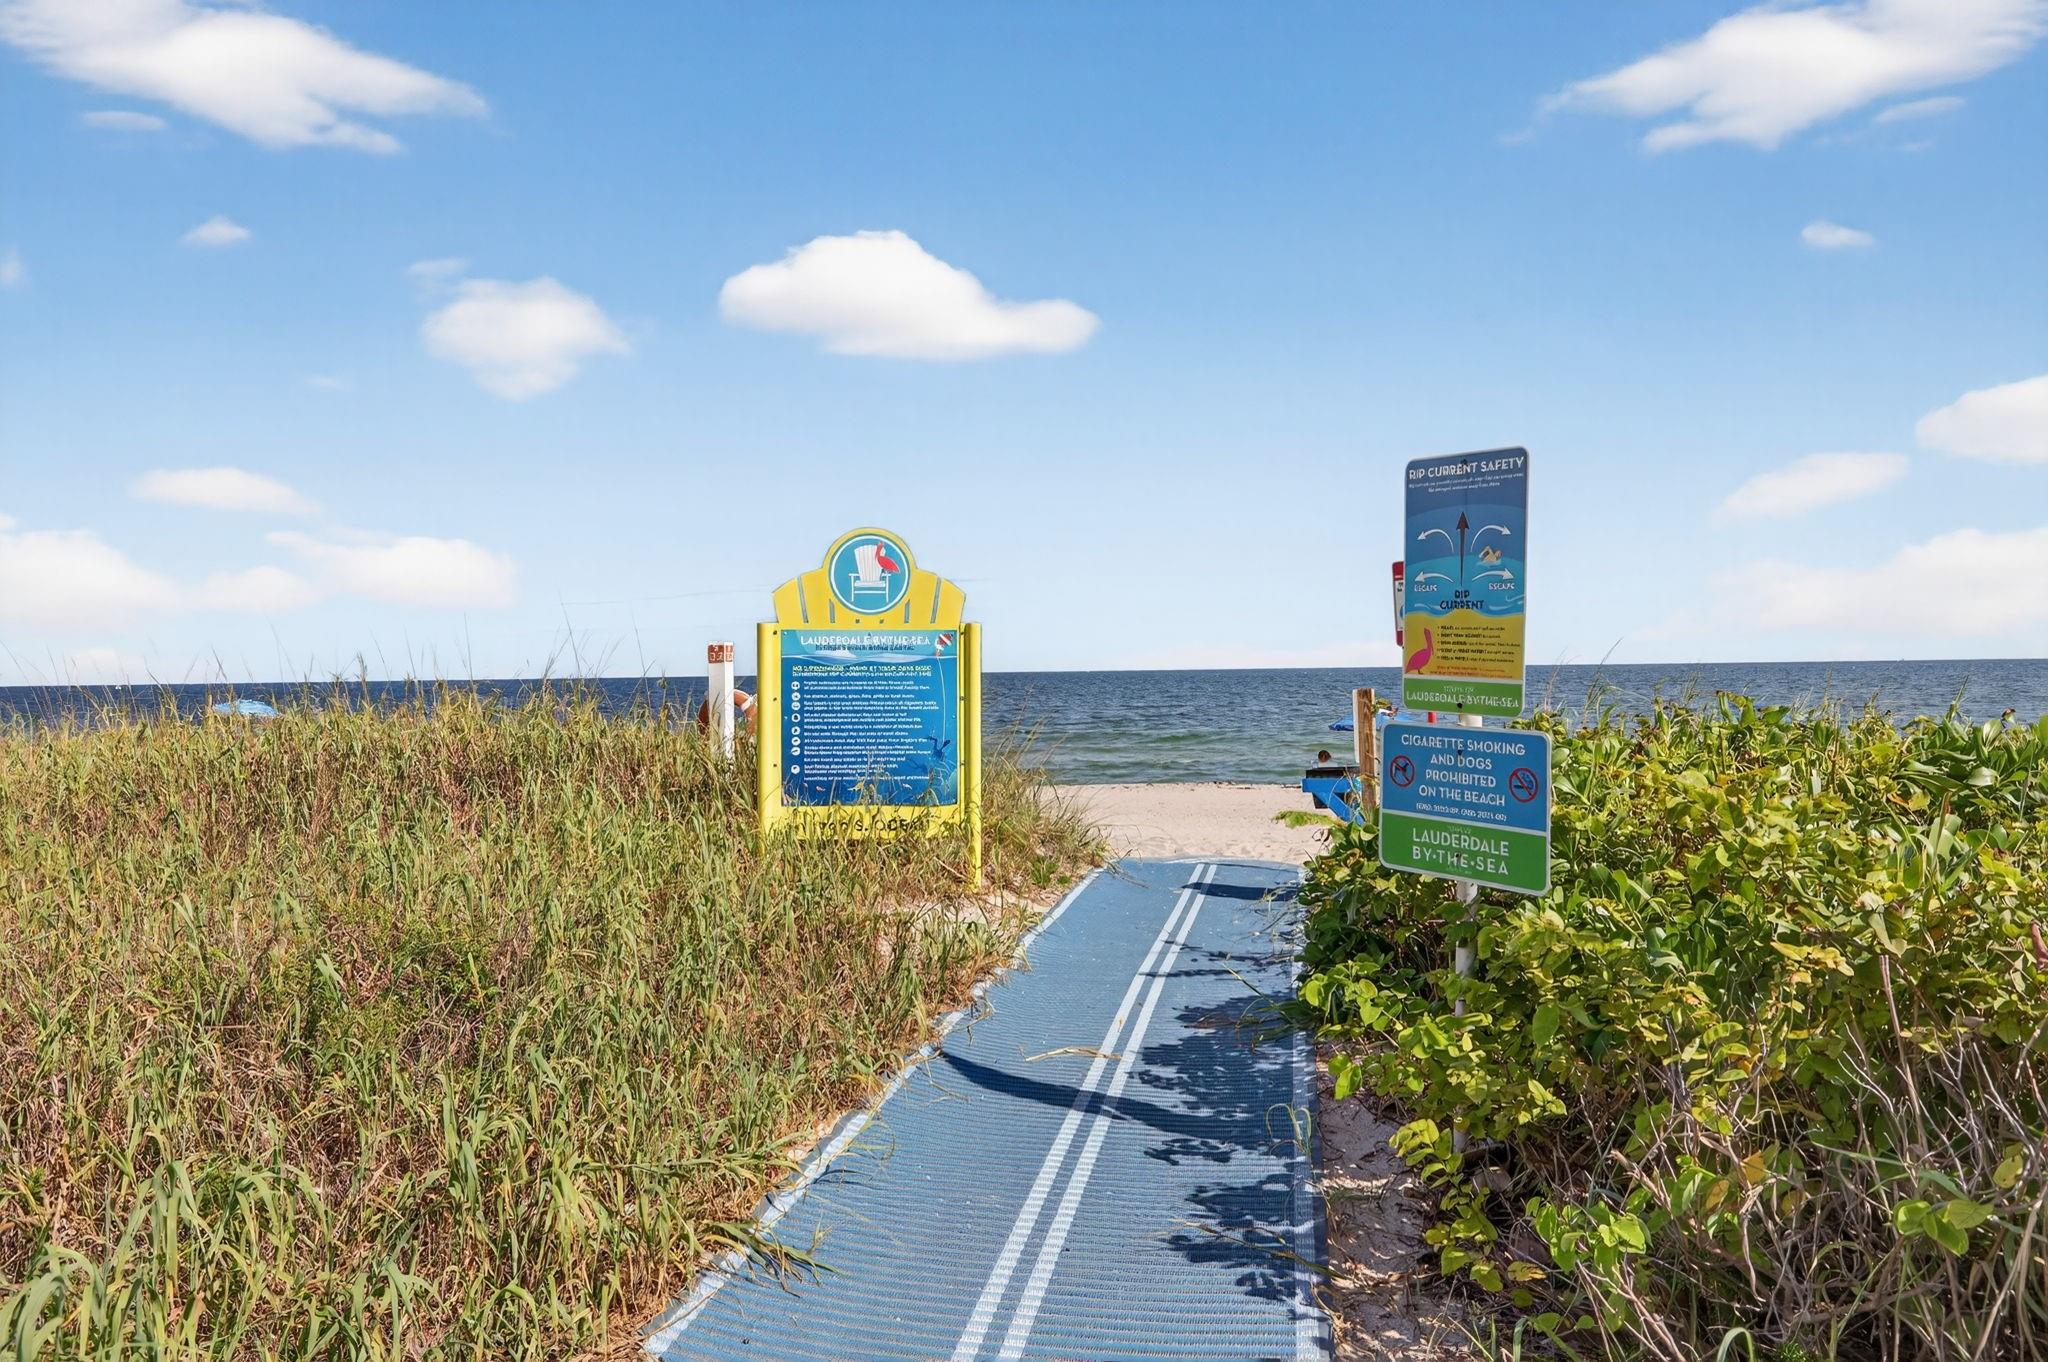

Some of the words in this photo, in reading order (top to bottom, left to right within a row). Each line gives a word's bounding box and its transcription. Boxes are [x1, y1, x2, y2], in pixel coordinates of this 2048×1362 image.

[1409, 469, 1425, 480] RIP
[1428, 462, 1478, 478] CURRENT
[1481, 456, 1525, 473] SAFETY
[1401, 734, 1464, 750] CIGARETTE
[1467, 739, 1526, 756] SMOKING
[1430, 754, 1455, 765] AND
[1457, 756, 1493, 770] DOGS
[1425, 769, 1497, 788] PROHIBITED
[1418, 784, 1436, 797] ON
[1439, 787, 1462, 801] THE
[1464, 791, 1506, 807] BEACH
[1412, 827, 1510, 857] LAUDERDALE
